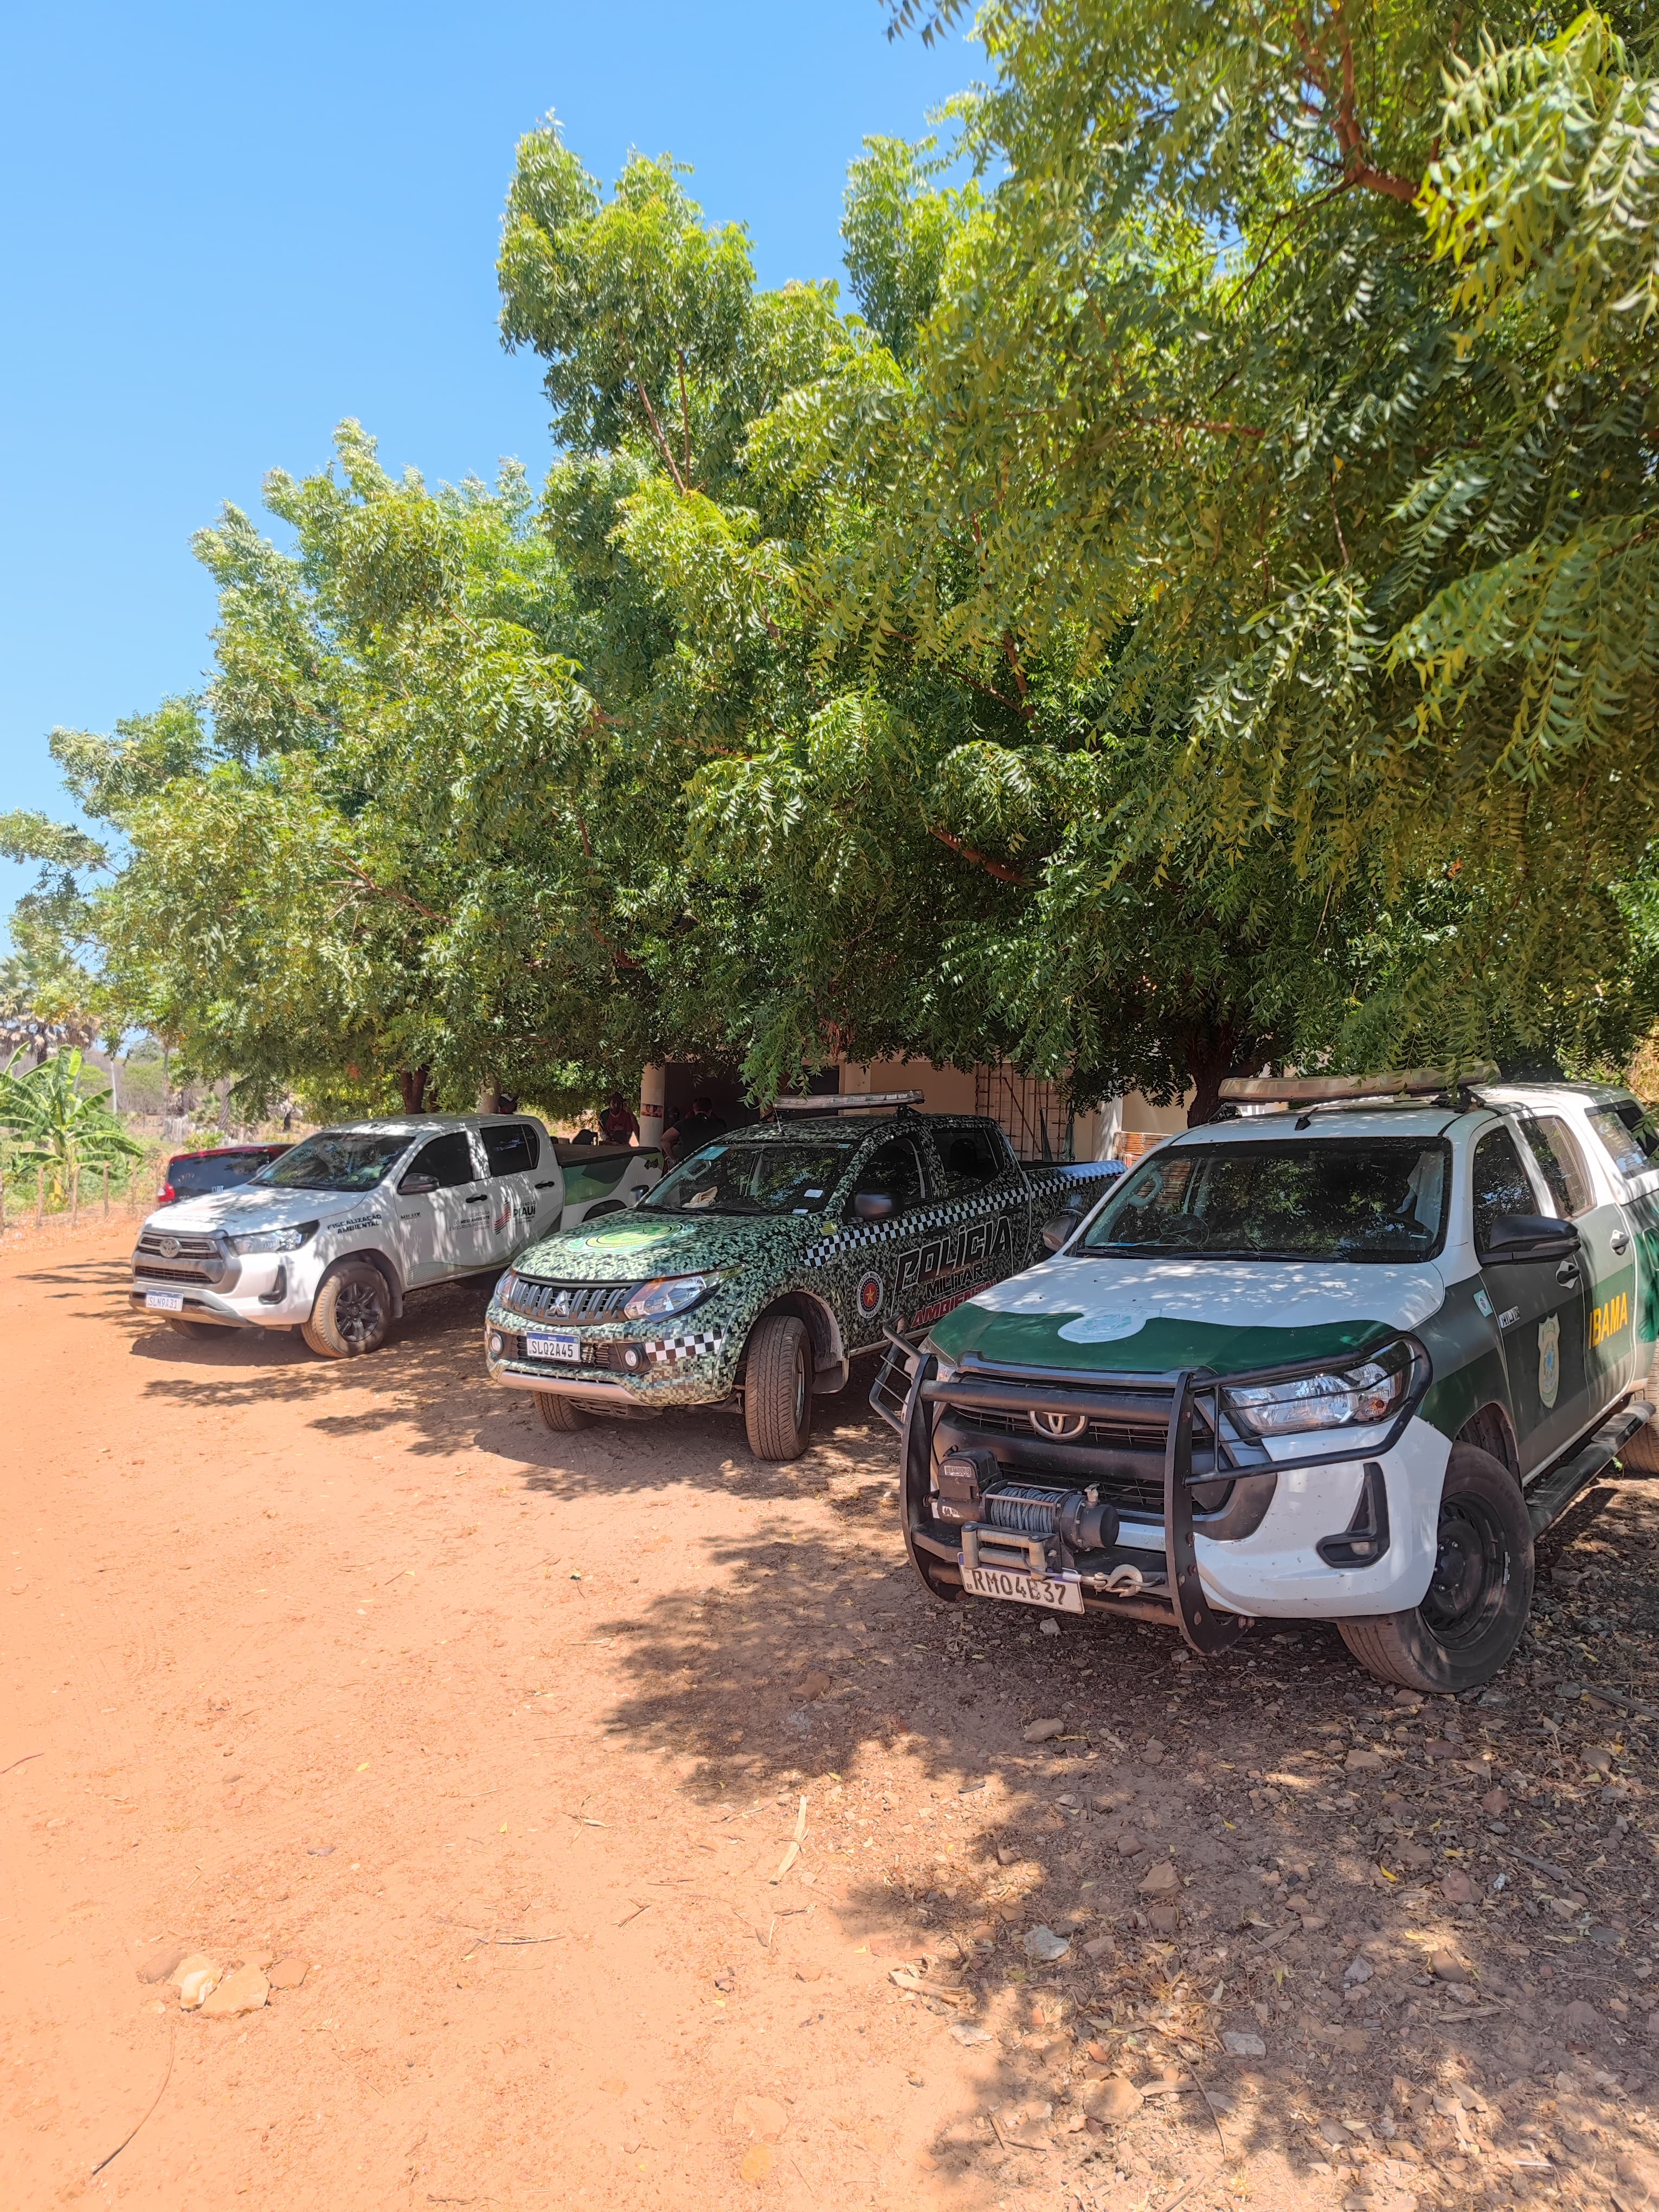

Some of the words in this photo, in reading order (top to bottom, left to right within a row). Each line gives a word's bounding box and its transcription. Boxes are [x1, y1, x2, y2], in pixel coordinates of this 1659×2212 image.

[337, 1220, 380, 1234] AMBIENTAL
[894, 1216, 1013, 1294] POLÍCIA
[926, 1262, 986, 1300] MILITAR
[149, 1296, 178, 1309] SLN9A31
[1589, 1292, 1628, 1350] IBAMA
[532, 1341, 573, 1358] SLQ2A45
[966, 1583, 974, 1591] BR
